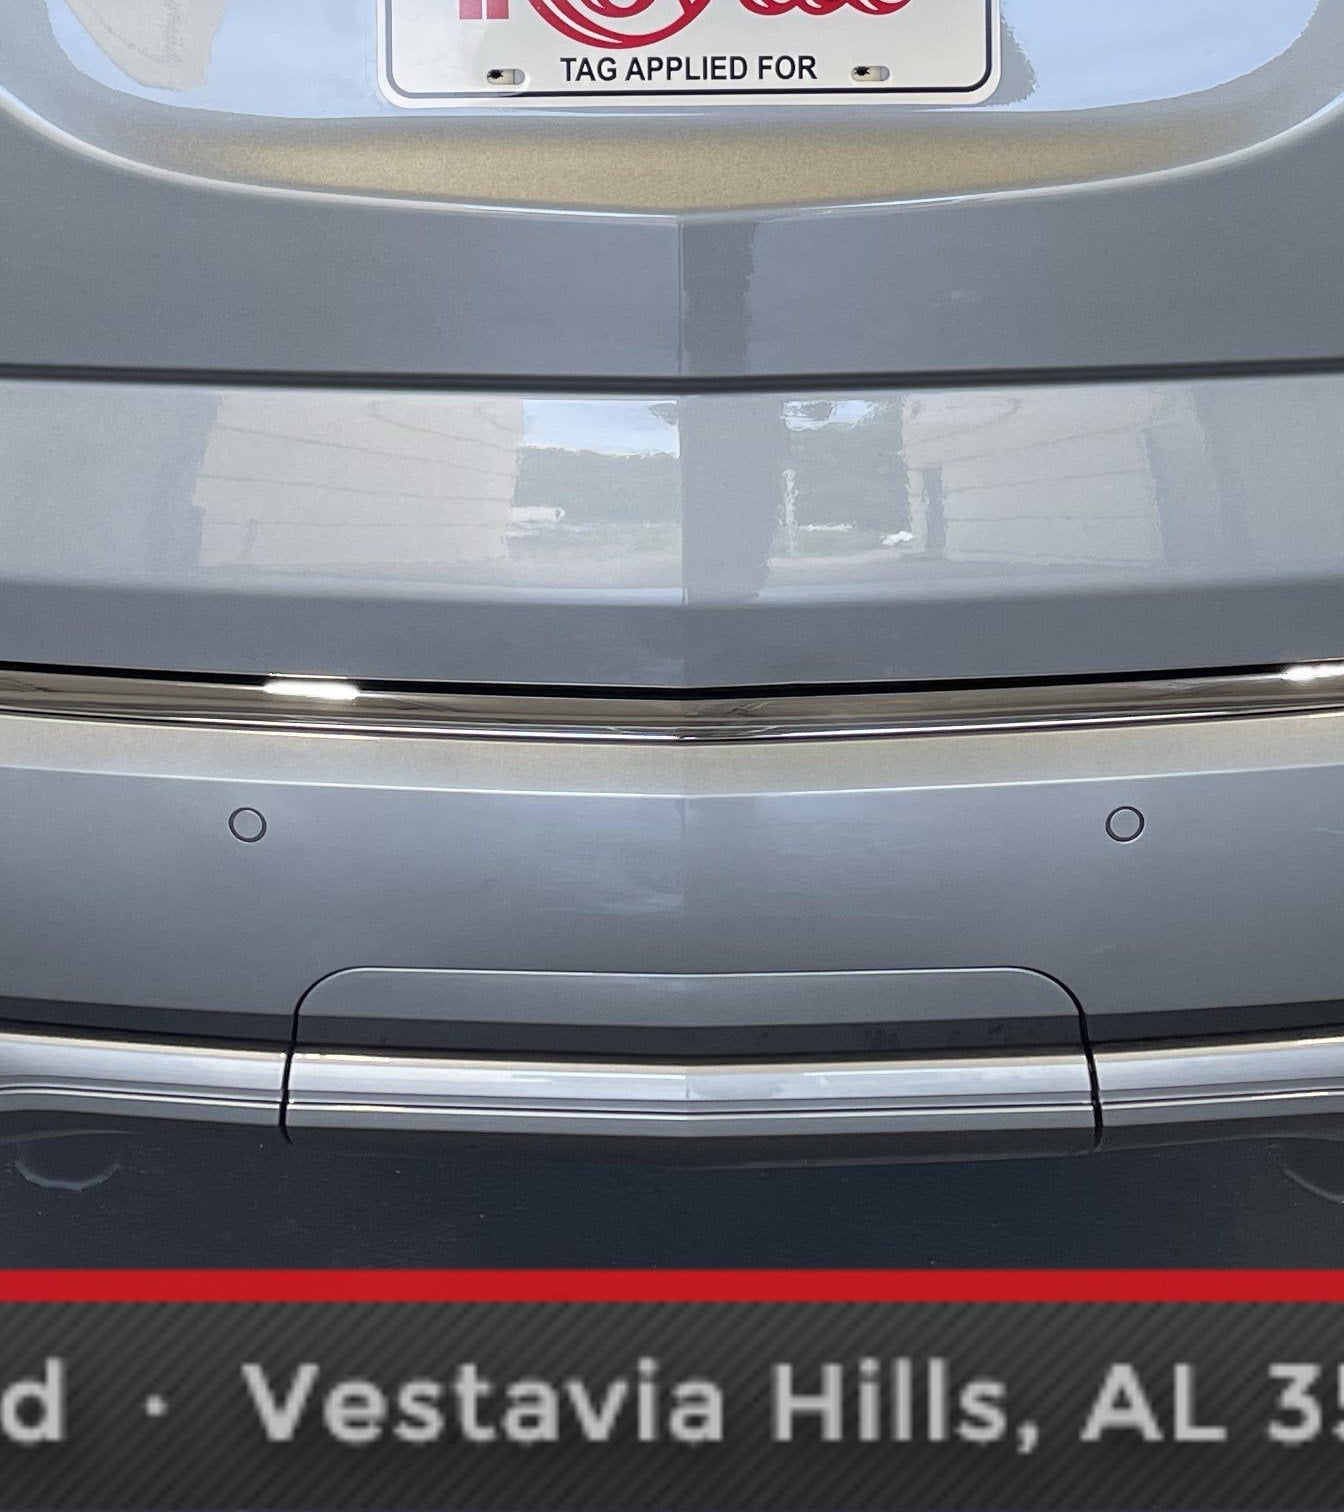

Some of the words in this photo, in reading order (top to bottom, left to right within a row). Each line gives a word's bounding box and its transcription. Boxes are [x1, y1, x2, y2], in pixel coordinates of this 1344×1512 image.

[560, 56, 617, 82] TAG
[625, 55, 748, 82] APPLIED
[757, 54, 818, 81] FOR
